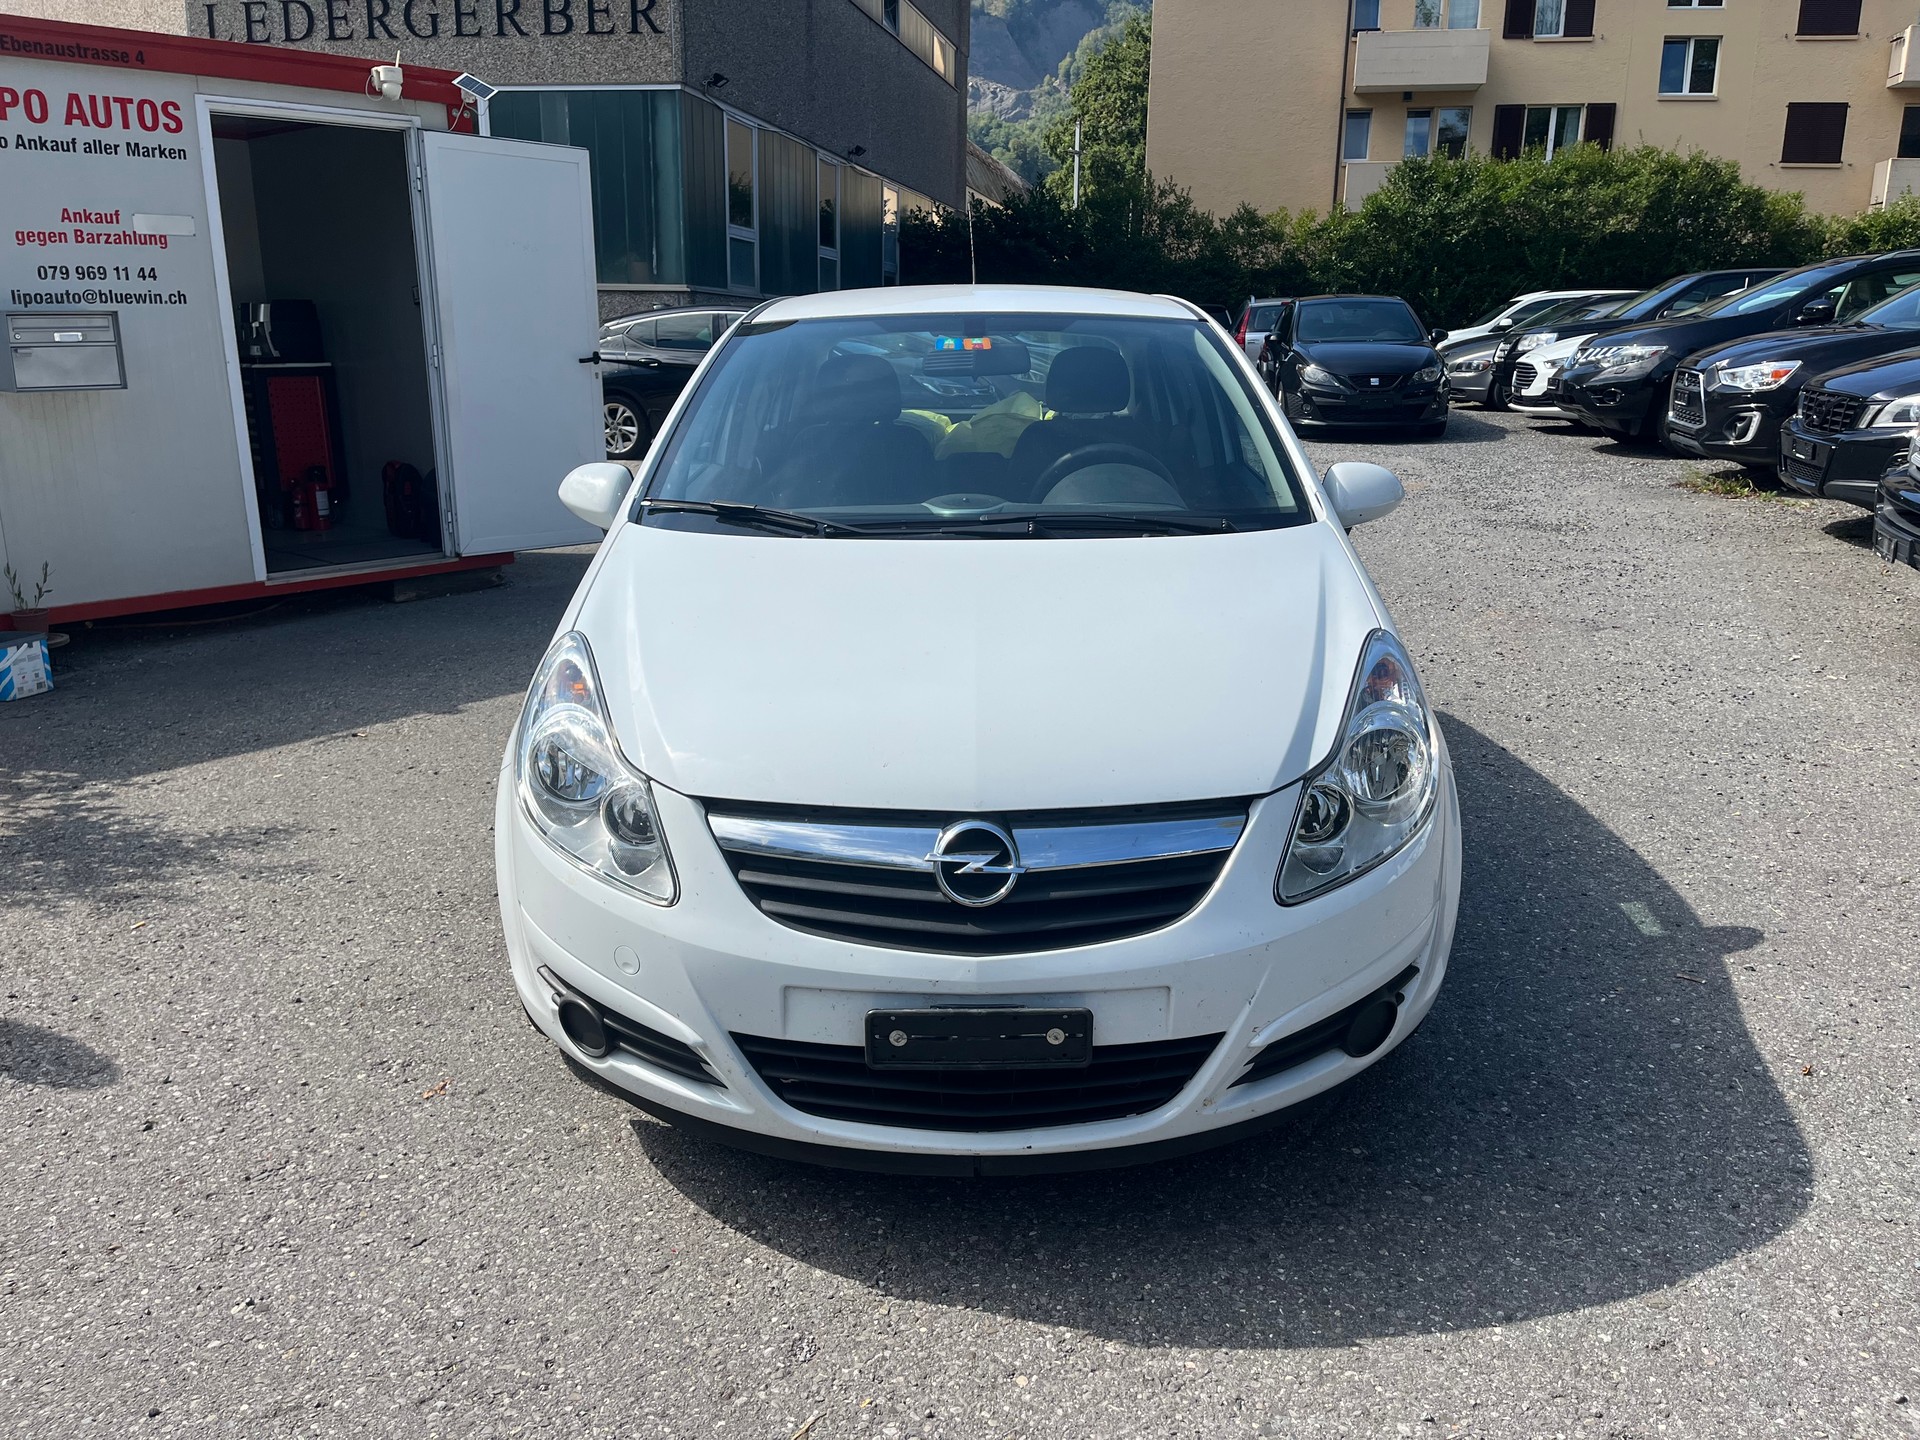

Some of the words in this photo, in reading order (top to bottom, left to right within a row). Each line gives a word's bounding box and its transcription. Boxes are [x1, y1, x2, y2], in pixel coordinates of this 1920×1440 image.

[205, 0, 664, 43] LEDERGERBER
[0, 34, 130, 64] Ebenaustrasse
[135, 50, 146, 65] 4
[0, 86, 49, 124] PO
[64, 92, 184, 134] AUTOS
[15, 134, 77, 153] Ankauf
[83, 139, 120, 156] aller
[126, 142, 188, 160] Marken
[60, 208, 121, 225] Ankauf
[15, 230, 69, 247] gegen
[73, 229, 169, 249] Barzahlung
[37, 265, 70, 281] 079
[75, 265, 108, 281] 969
[113, 266, 130, 282] 11
[137, 267, 158, 282] 44
[10, 289, 188, 309] lipoauto@bluewin.ch
